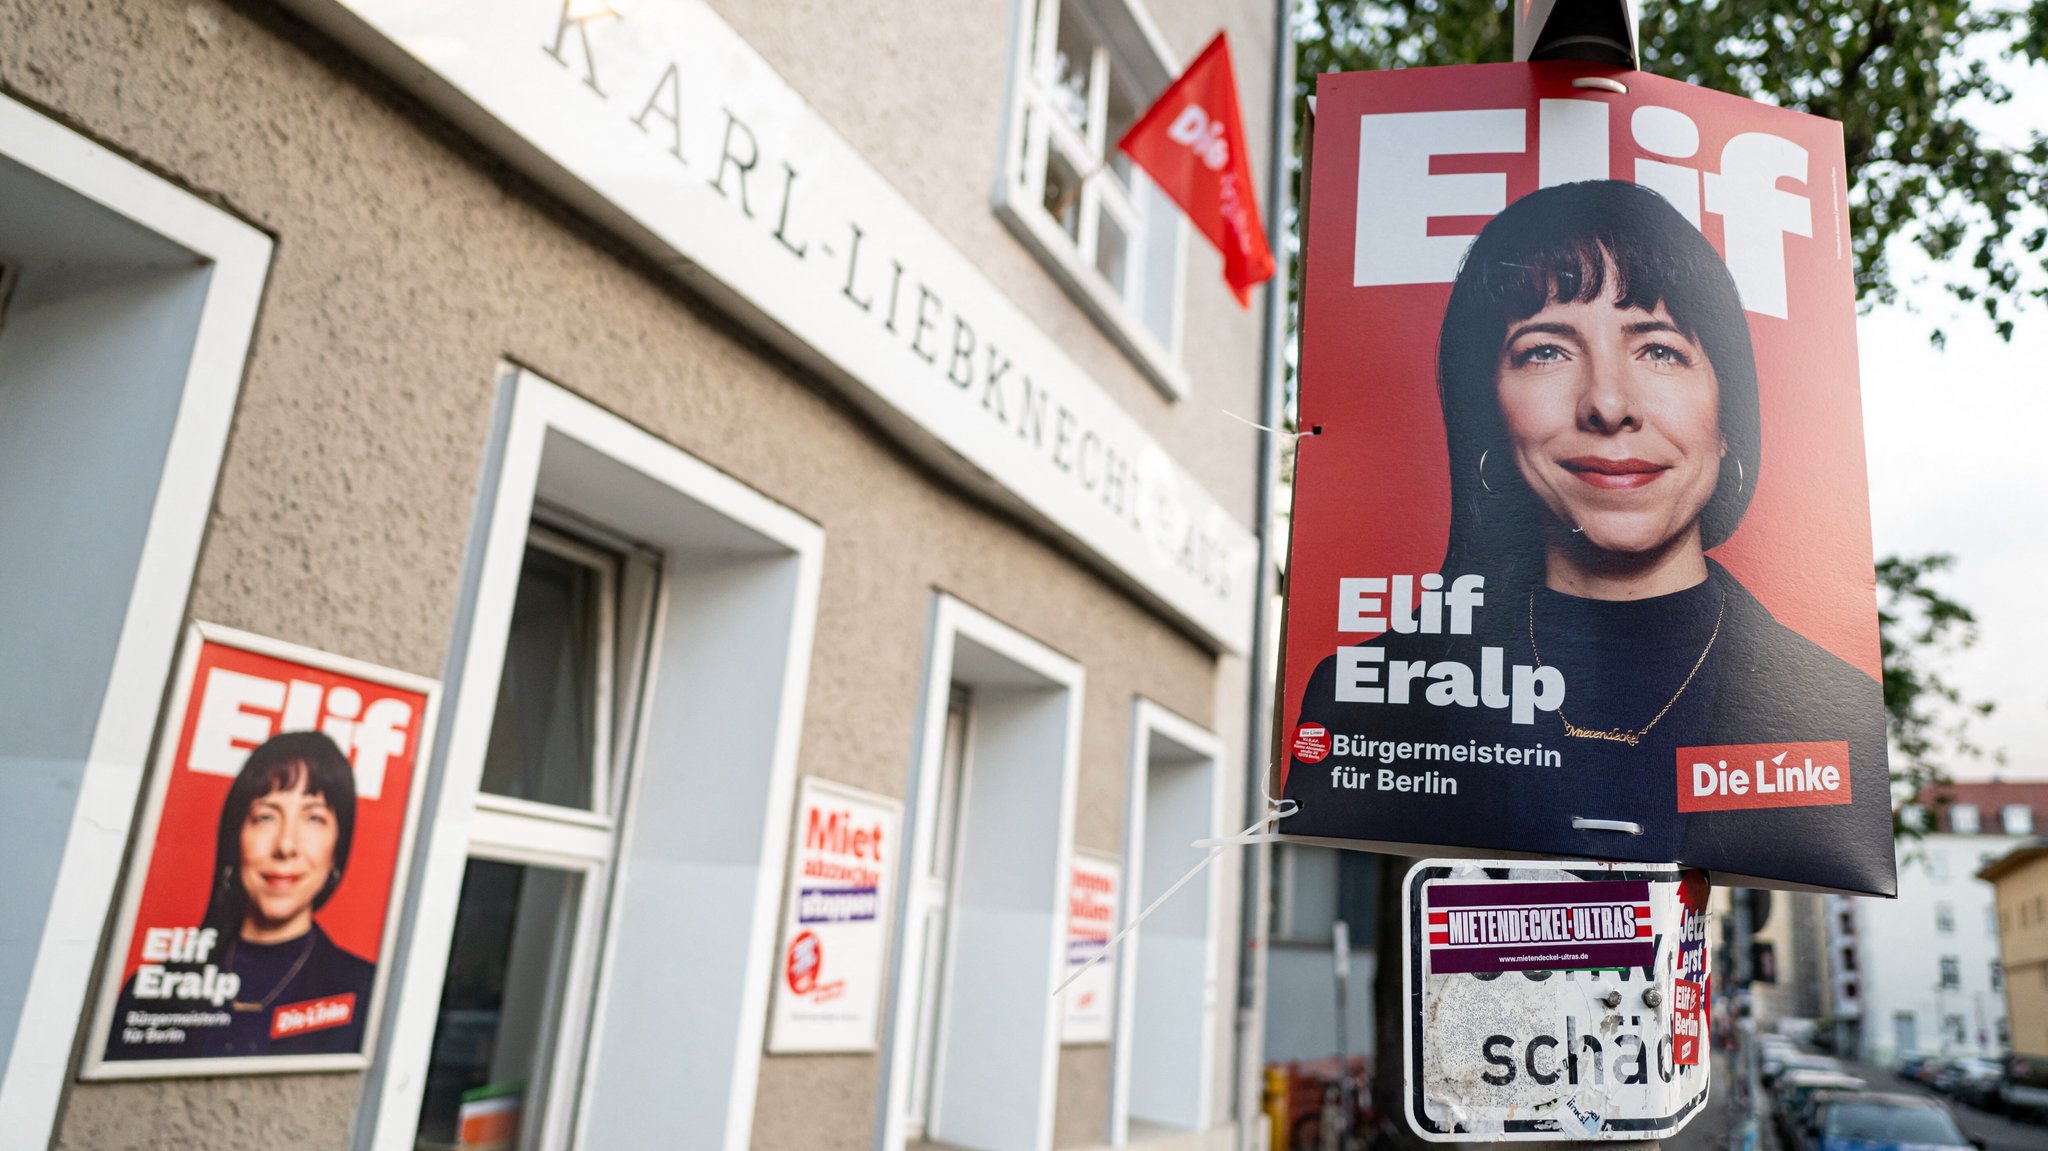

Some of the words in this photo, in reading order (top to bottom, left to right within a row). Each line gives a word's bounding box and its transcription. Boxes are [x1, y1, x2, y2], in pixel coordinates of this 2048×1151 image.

[1338, 573, 1486, 636] Elif
[1334, 645, 1567, 725] Eralp
[1332, 734, 1562, 768] Bürgermeisterin
[1331, 766, 1370, 790] für
[1377, 768, 1457, 795] Berlin
[1693, 760, 1749, 797] Die
[1756, 751, 1840, 795] Linke
[806, 805, 883, 862] Miet
[1448, 905, 1636, 944] MIETENDECKEL-ULTRAS
[1680, 908, 1708, 943] Jetz
[141, 927, 218, 964] Elif
[1499, 952, 1589, 963] www.mietendeckel-ultras.de
[1682, 941, 1702, 974] erst
[133, 964, 241, 1007] Eralp
[1675, 985, 1690, 1010] Elif
[276, 1012, 303, 1032] Die
[304, 1001, 350, 1025] Linke
[1675, 1011, 1698, 1037] Berlin
[1481, 1016, 1691, 1086] schäd
[1566, 1095, 1590, 1124] links!
